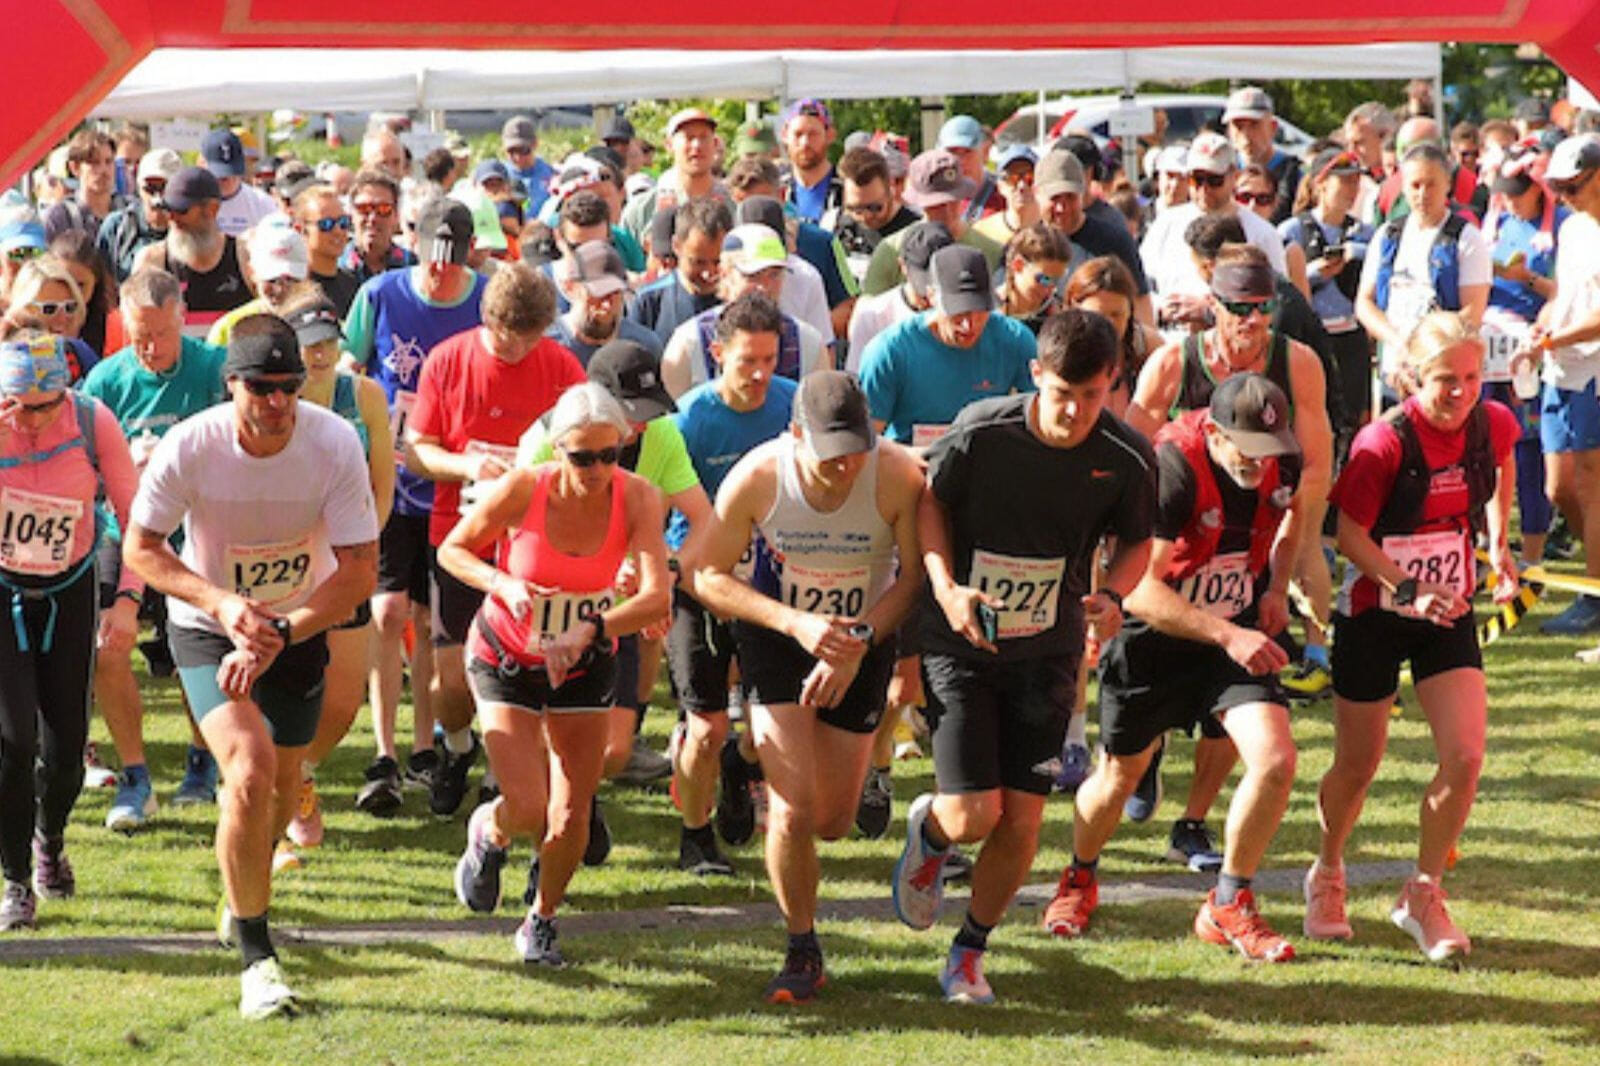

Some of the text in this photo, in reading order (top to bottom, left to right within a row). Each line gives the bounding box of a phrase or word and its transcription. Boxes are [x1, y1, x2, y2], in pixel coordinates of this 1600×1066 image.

[3, 511, 72, 545] 1045
[235, 552, 310, 588] 1229
[1394, 550, 1460, 584] 282
[790, 584, 863, 618] 1230
